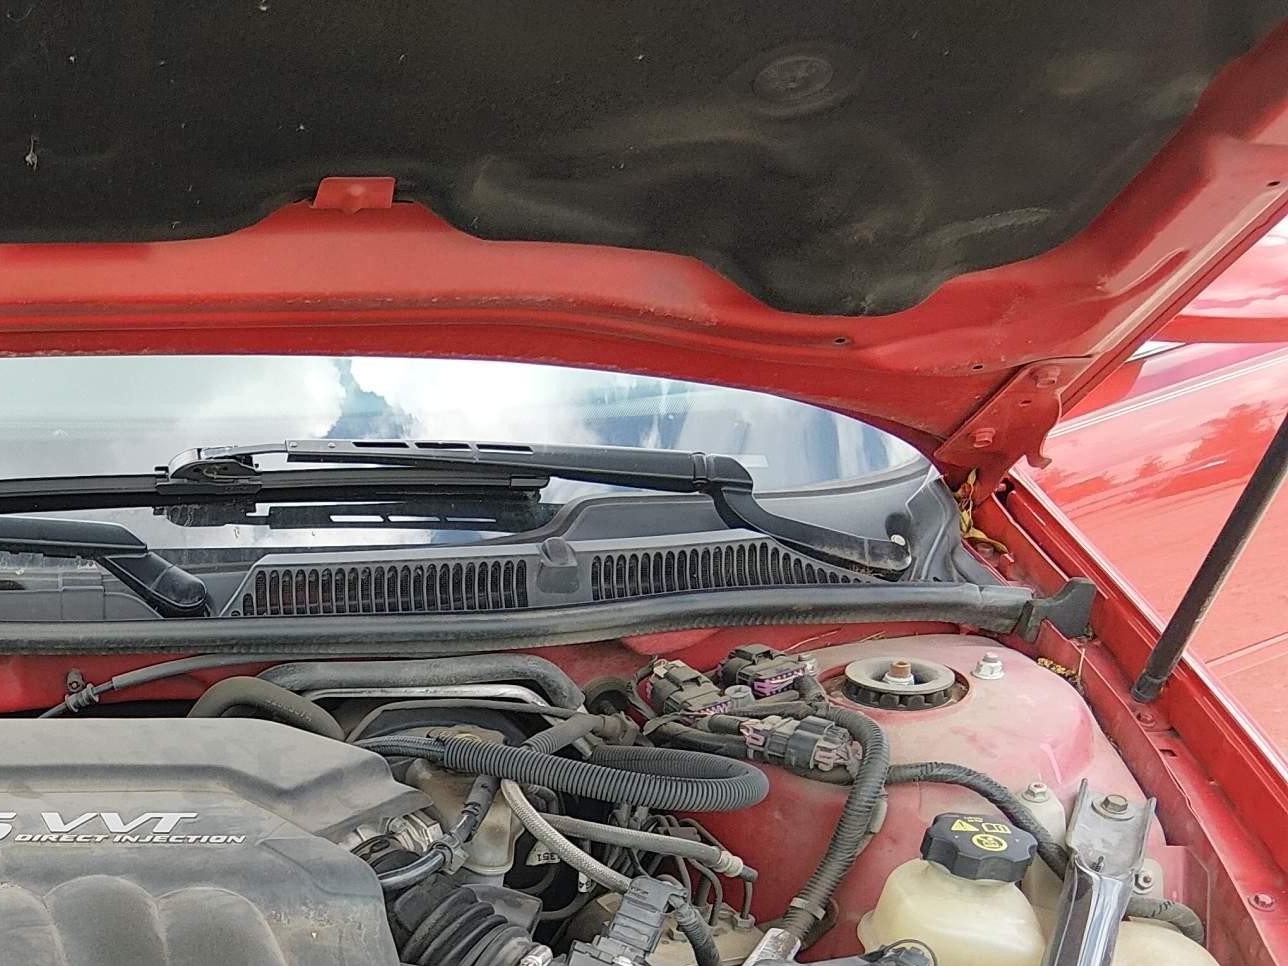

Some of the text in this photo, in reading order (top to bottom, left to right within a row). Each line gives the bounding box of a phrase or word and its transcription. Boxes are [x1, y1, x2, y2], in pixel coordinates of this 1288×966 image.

[41, 812, 199, 834] VVT
[14, 834, 246, 844] DIRECT INJECTION
